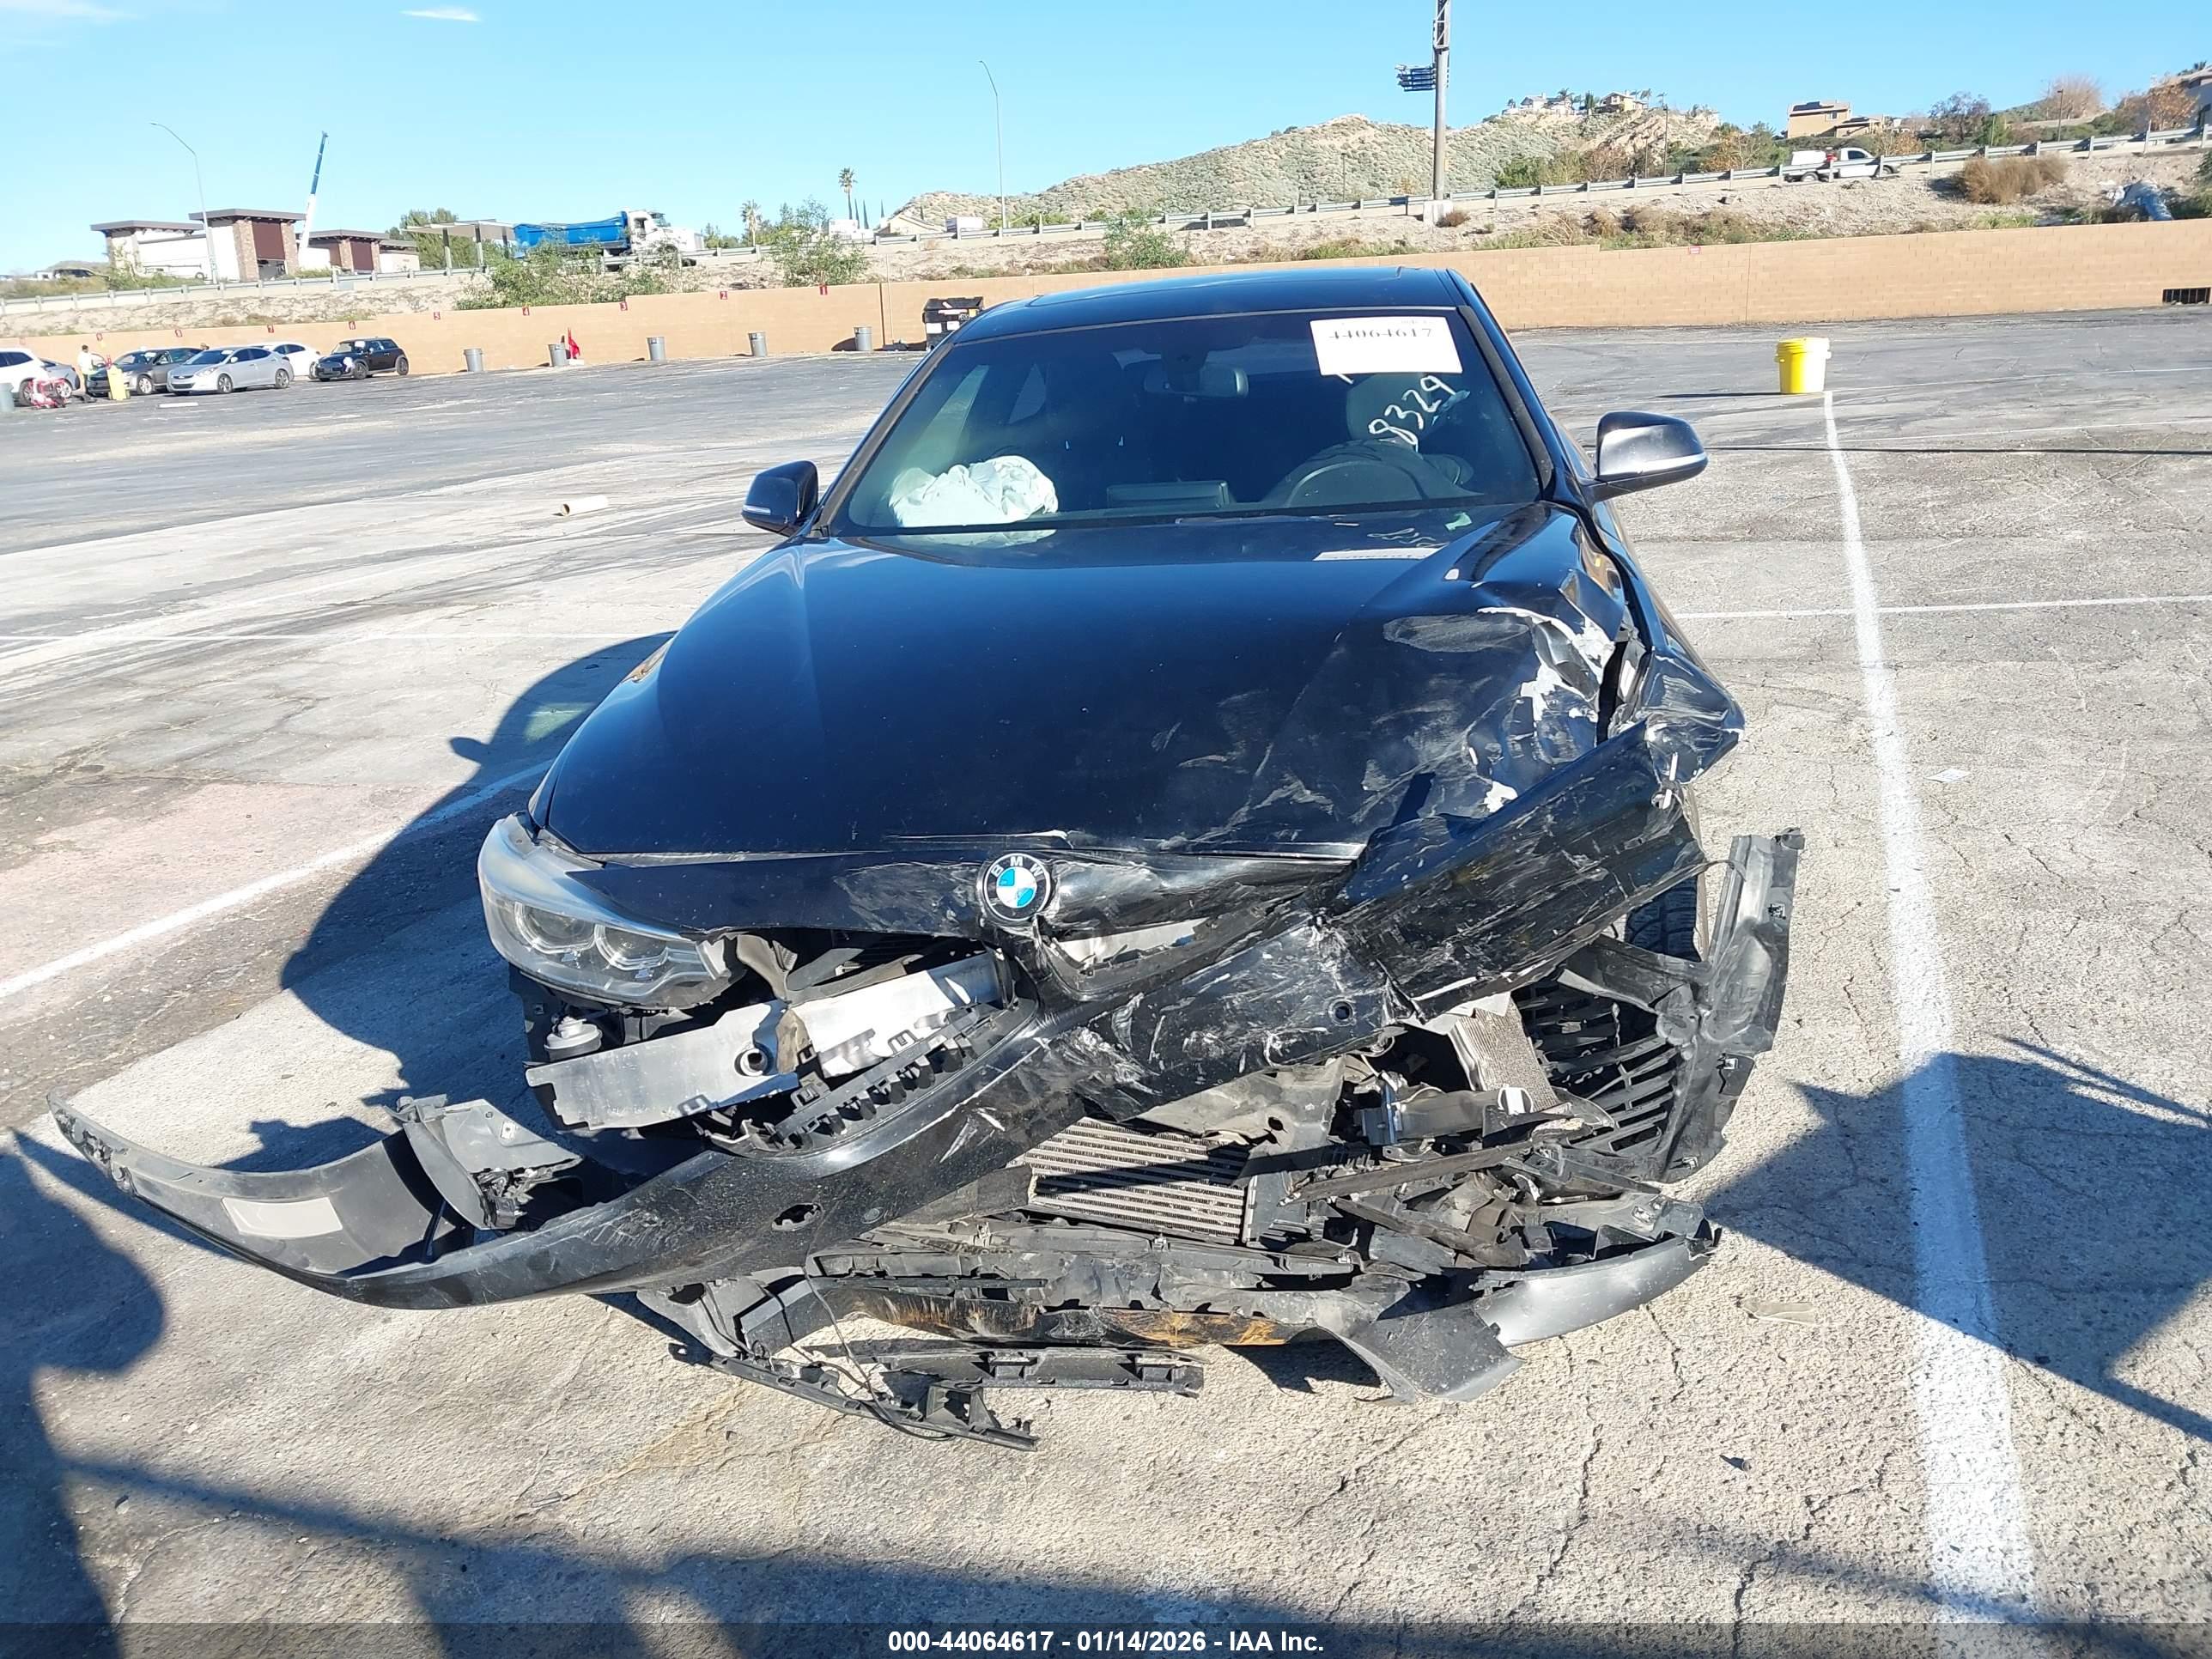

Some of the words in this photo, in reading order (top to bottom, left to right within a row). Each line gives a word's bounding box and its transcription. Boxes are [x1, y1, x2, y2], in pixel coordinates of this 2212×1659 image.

[1328, 327, 1432, 339] 44064617
[1368, 374, 1457, 447] 8329
[991, 856, 1044, 880] BMW
